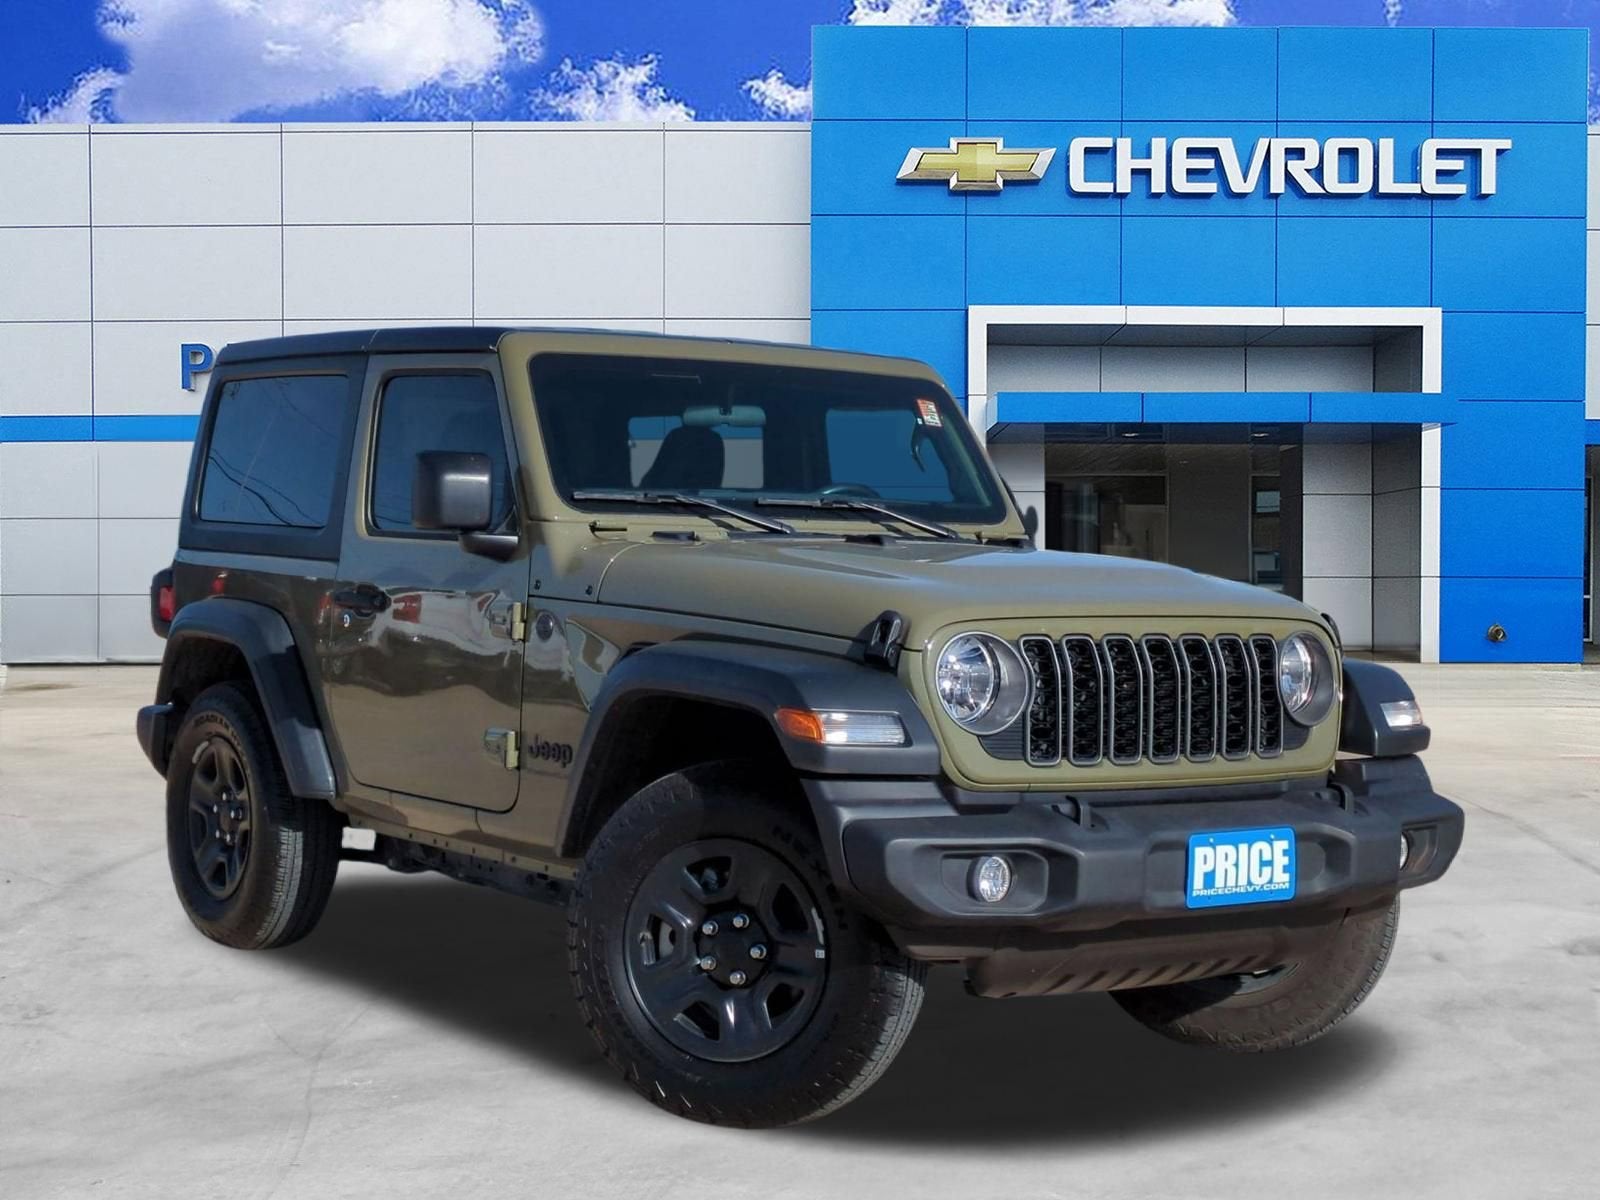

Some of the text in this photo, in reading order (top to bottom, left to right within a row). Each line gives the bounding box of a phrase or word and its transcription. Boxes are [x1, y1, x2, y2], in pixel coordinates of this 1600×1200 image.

[1069, 137, 1512, 195] CHEVROLET
[528, 734, 573, 768] Jeep
[1193, 840, 1290, 890] PRICE
[1192, 882, 1290, 897] PRICECHEVY.COM
